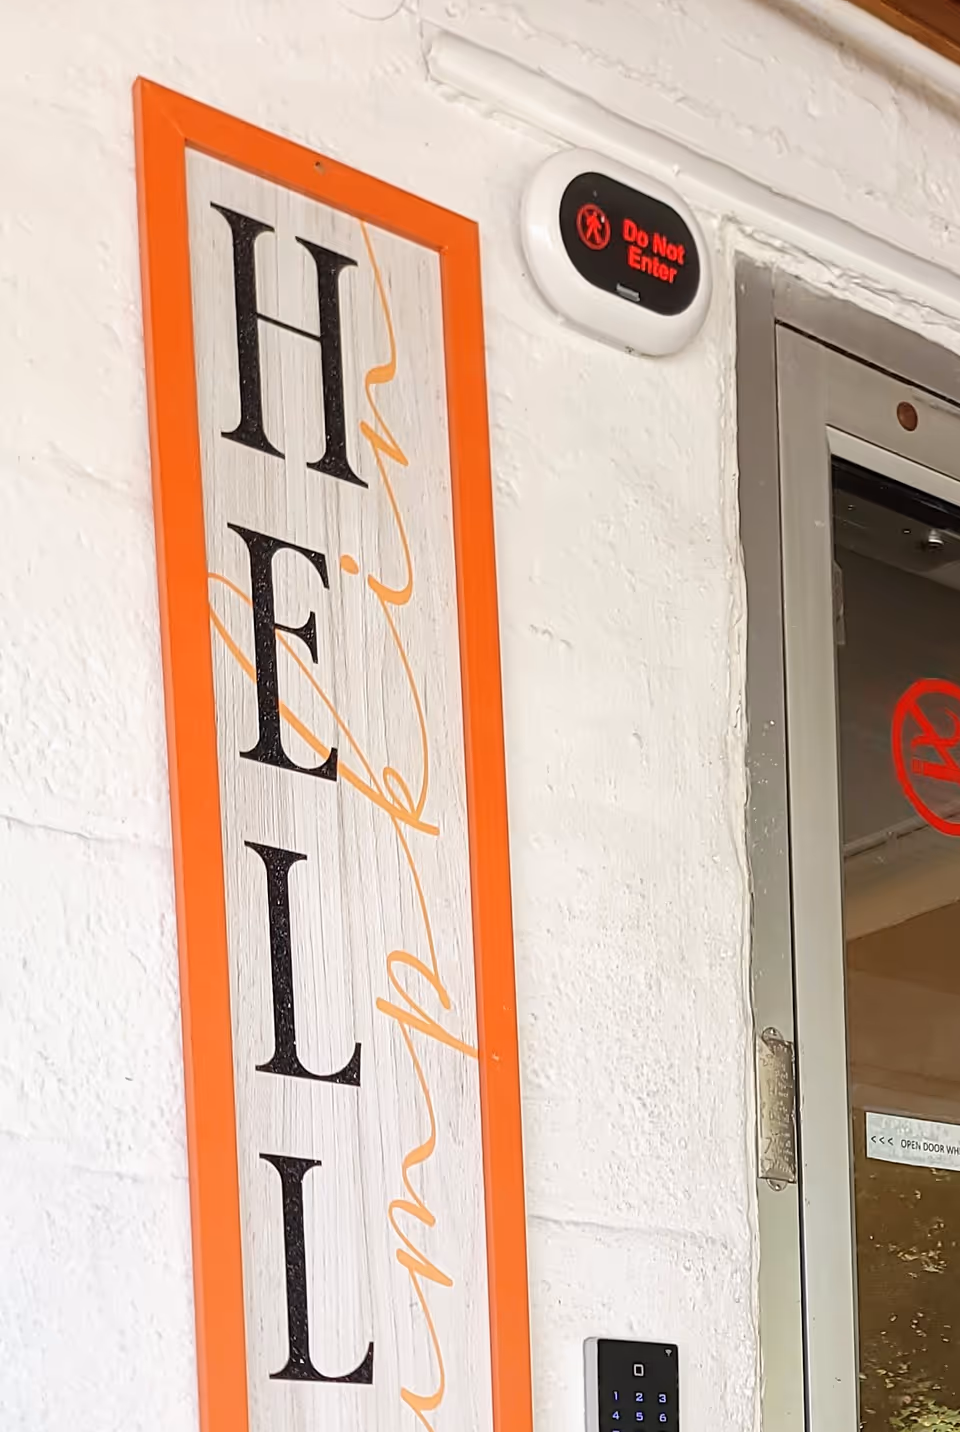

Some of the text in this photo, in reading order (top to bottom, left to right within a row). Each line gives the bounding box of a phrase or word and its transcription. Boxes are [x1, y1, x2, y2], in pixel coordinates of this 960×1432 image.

[623, 218, 685, 265] Do Not
[628, 245, 677, 283] Enter
[901, 1139, 921, 1150] OPEN
[923, 1142, 945, 1154] DOOR
[614, 1391, 666, 1403] 1 2 3
[612, 1411, 667, 1422] 4 5 6
